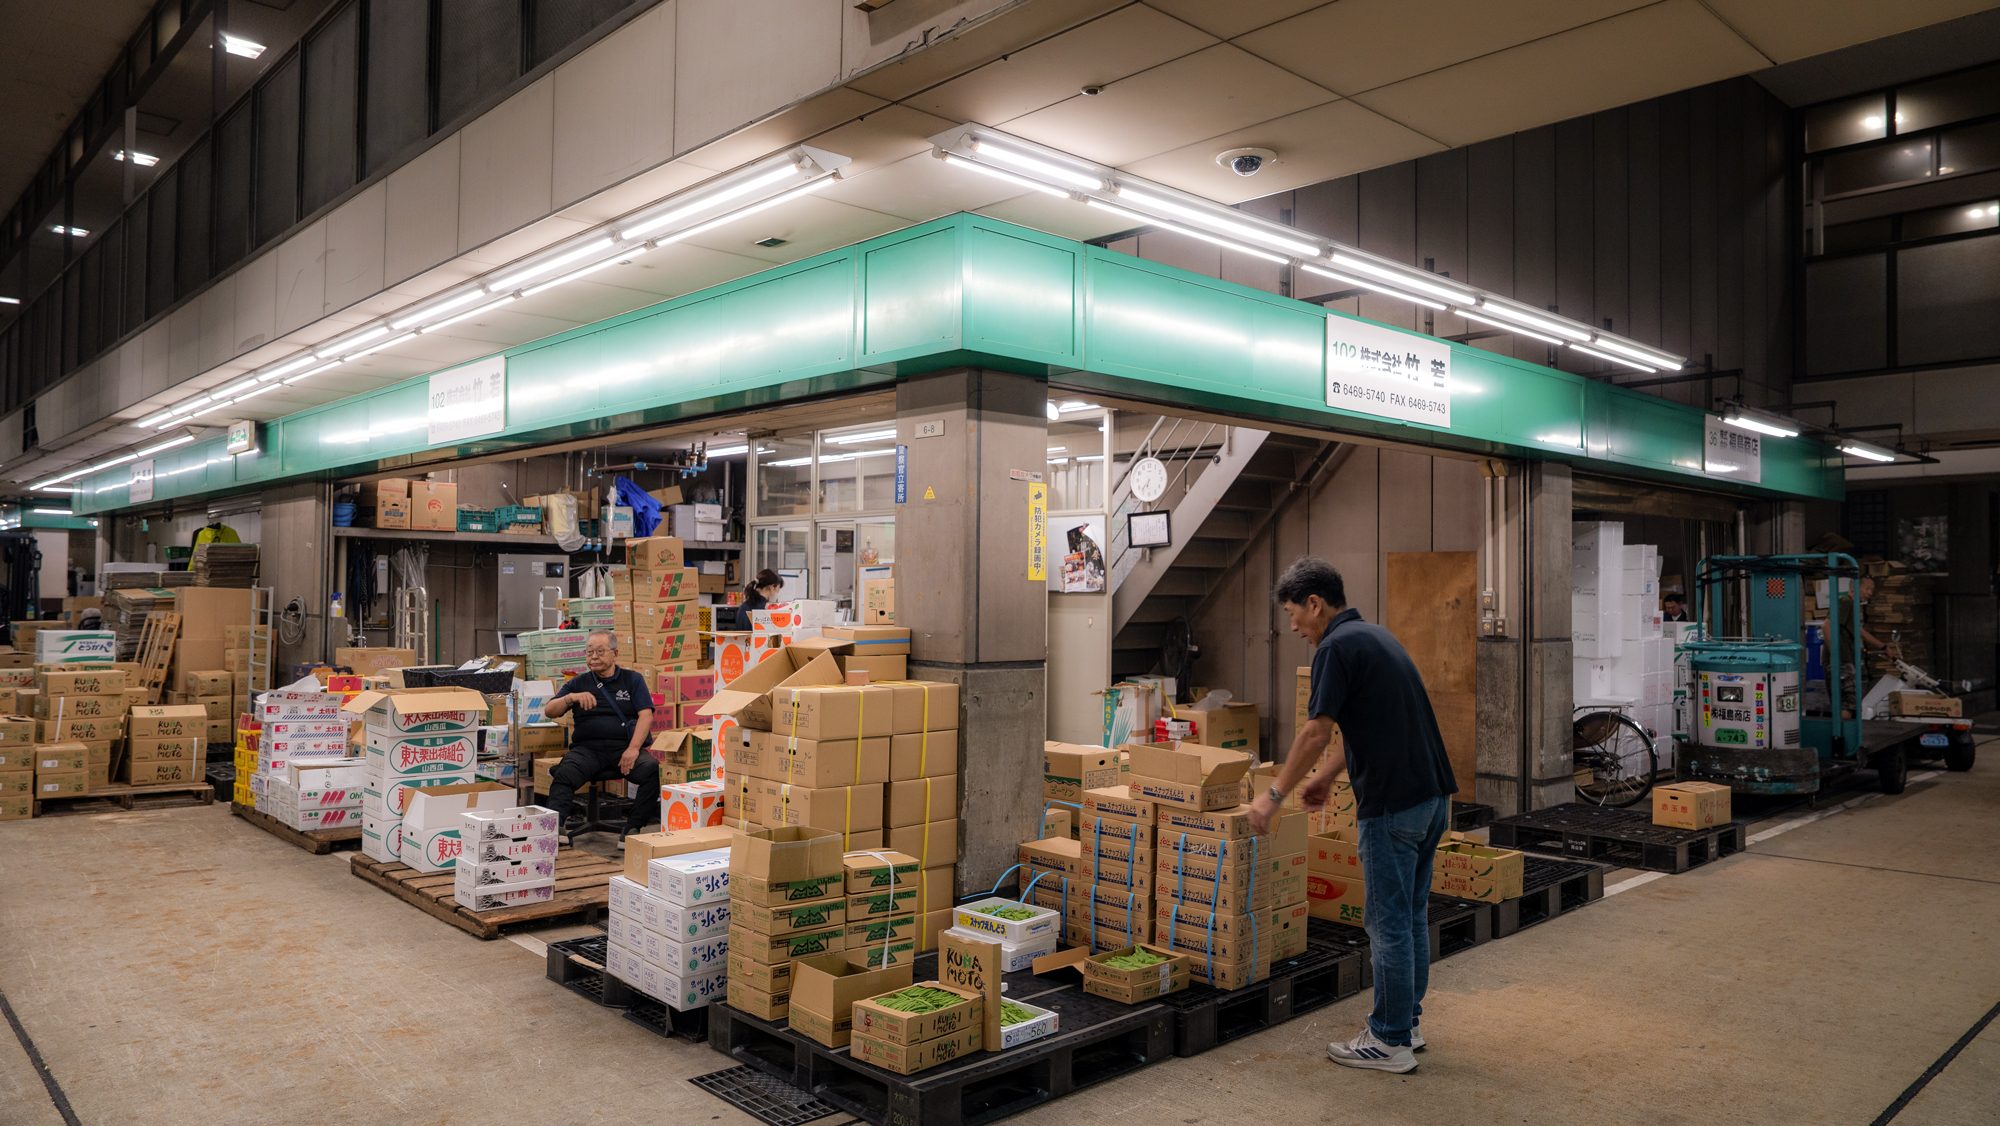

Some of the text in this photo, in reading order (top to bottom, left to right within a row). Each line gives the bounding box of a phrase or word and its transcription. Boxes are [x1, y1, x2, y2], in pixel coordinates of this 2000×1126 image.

[432, 392, 446, 408] 102
[1343, 384, 1446, 414] 6469-5740 FAX 6469-5743
[923, 425, 934, 434] 6-8
[400, 741, 465, 768] 東大栗出荷組合
[1154, 786, 1184, 799] スナップえんどう
[1108, 802, 1137, 814] スナップえんどう
[511, 821, 532, 832] 巨峰
[1183, 816, 1214, 828] スナップえんどう
[508, 844, 532, 855] 巨峰
[506, 867, 528, 878] 巨峰
[701, 907, 731, 927] 水な
[970, 918, 1005, 934] スナップえんどう
[946, 948, 982, 972] KUMA
[946, 966, 984, 990] MOTO
